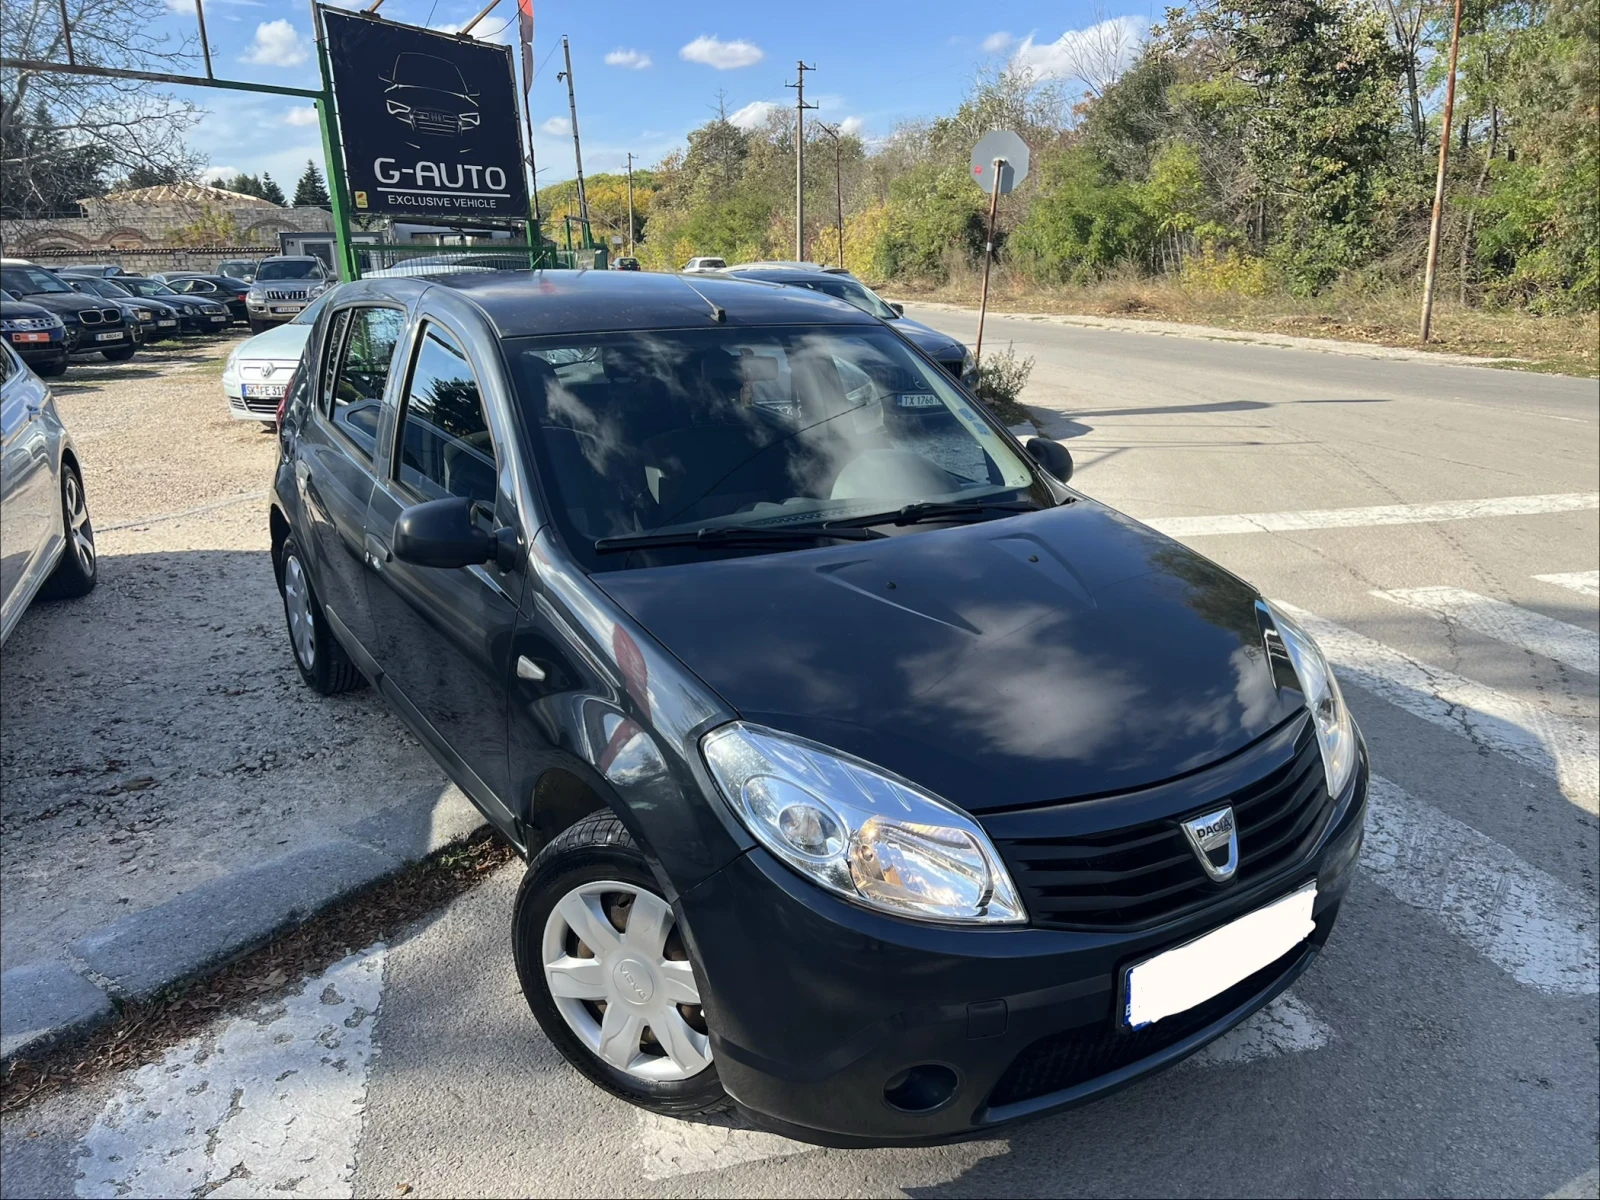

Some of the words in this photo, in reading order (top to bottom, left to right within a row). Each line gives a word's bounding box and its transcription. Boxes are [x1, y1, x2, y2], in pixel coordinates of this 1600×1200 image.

[372, 157, 507, 191] G-AUTO
[388, 194, 451, 207] EXCLUSIVE
[453, 196, 497, 209] VEHICLE
[247, 386, 256, 396] SK
[260, 386, 271, 396] FE
[904, 396, 915, 406] TX
[917, 395, 934, 405] 1768
[1196, 817, 1232, 839] DACIA
